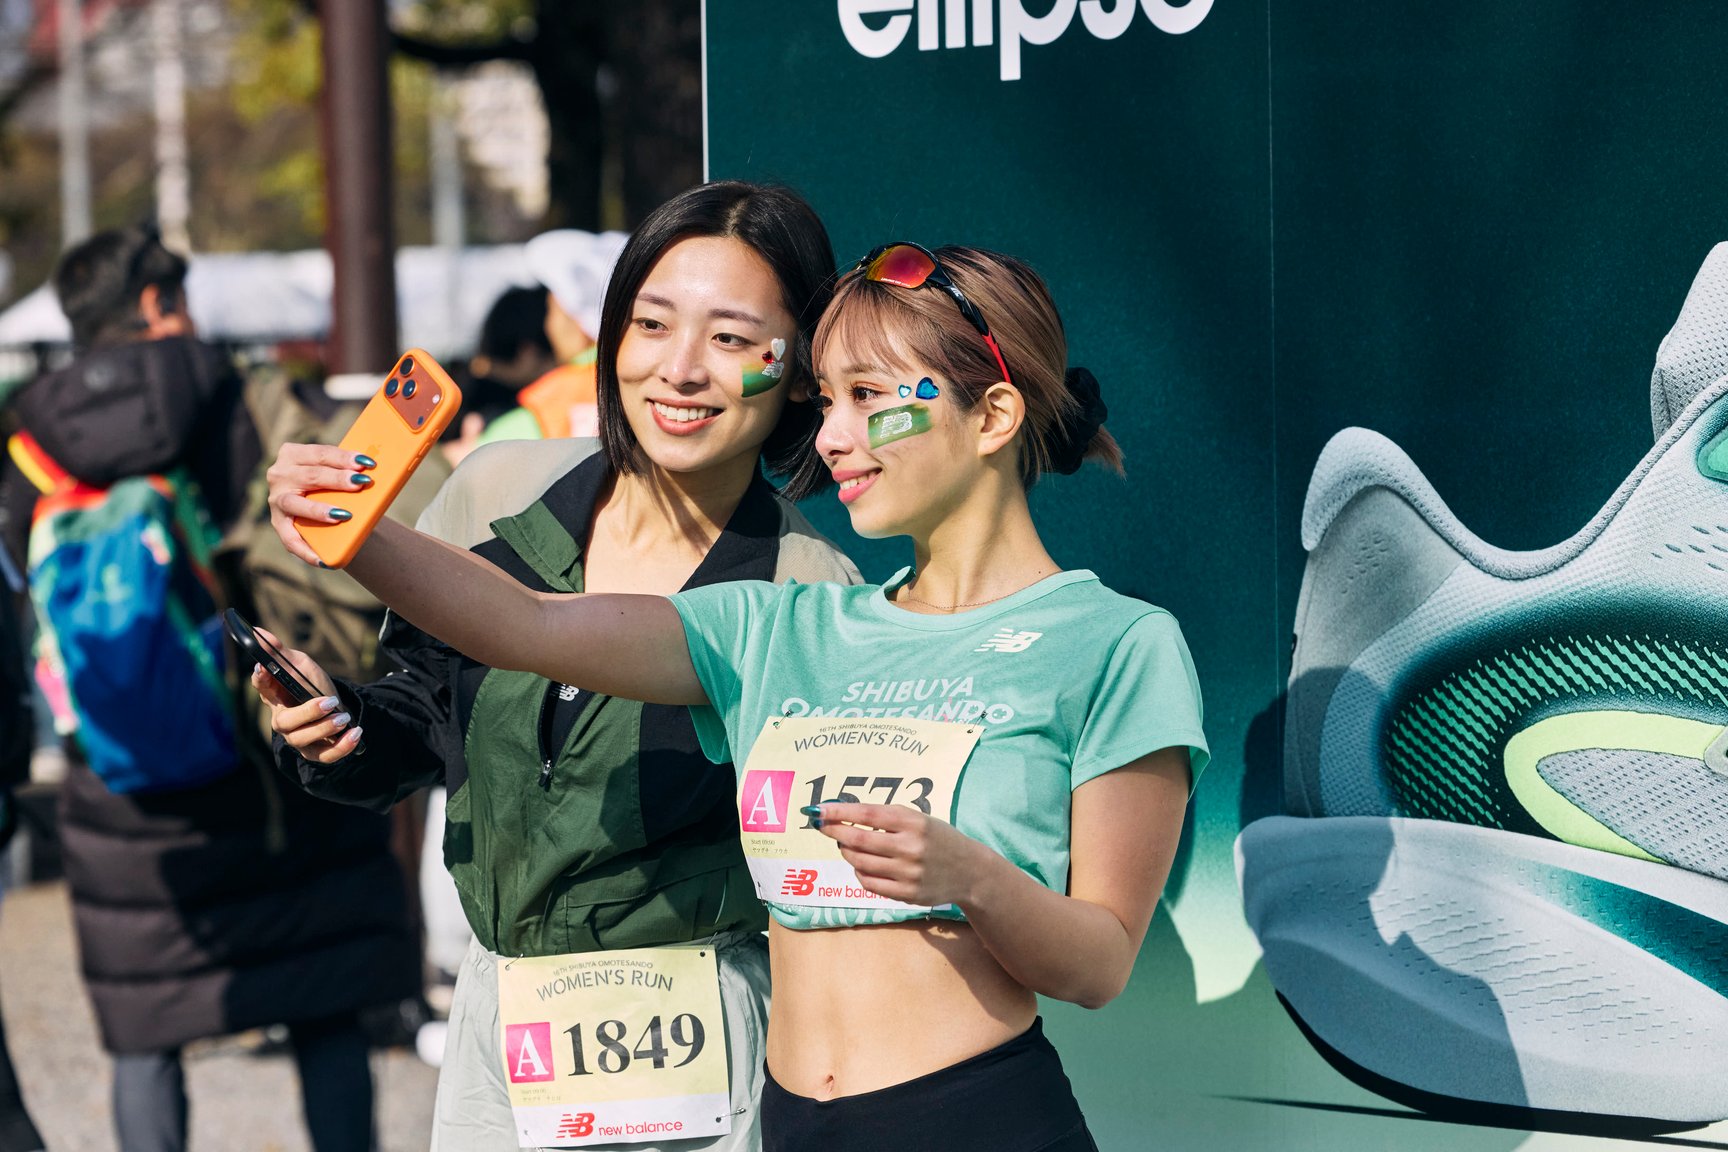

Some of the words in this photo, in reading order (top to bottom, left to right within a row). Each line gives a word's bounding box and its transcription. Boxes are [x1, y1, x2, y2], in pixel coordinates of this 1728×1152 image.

[841, 676, 974, 703] SHIBUYA
[838, 723, 868, 731] SHIBUYA
[869, 723, 918, 736] OMOTESANDO
[794, 731, 888, 753] WOMEN'S
[889, 734, 929, 756] RUN
[746, 776, 781, 825] A
[818, 886, 842, 898] new
[597, 959, 654, 969] OMOTESANDO
[536, 969, 625, 1001] WOMEN'S
[631, 970, 673, 992] RUN
[514, 1029, 549, 1077] A
[563, 1013, 706, 1077] 1849
[598, 1126, 622, 1136] new
[625, 1121, 683, 1135] balance
